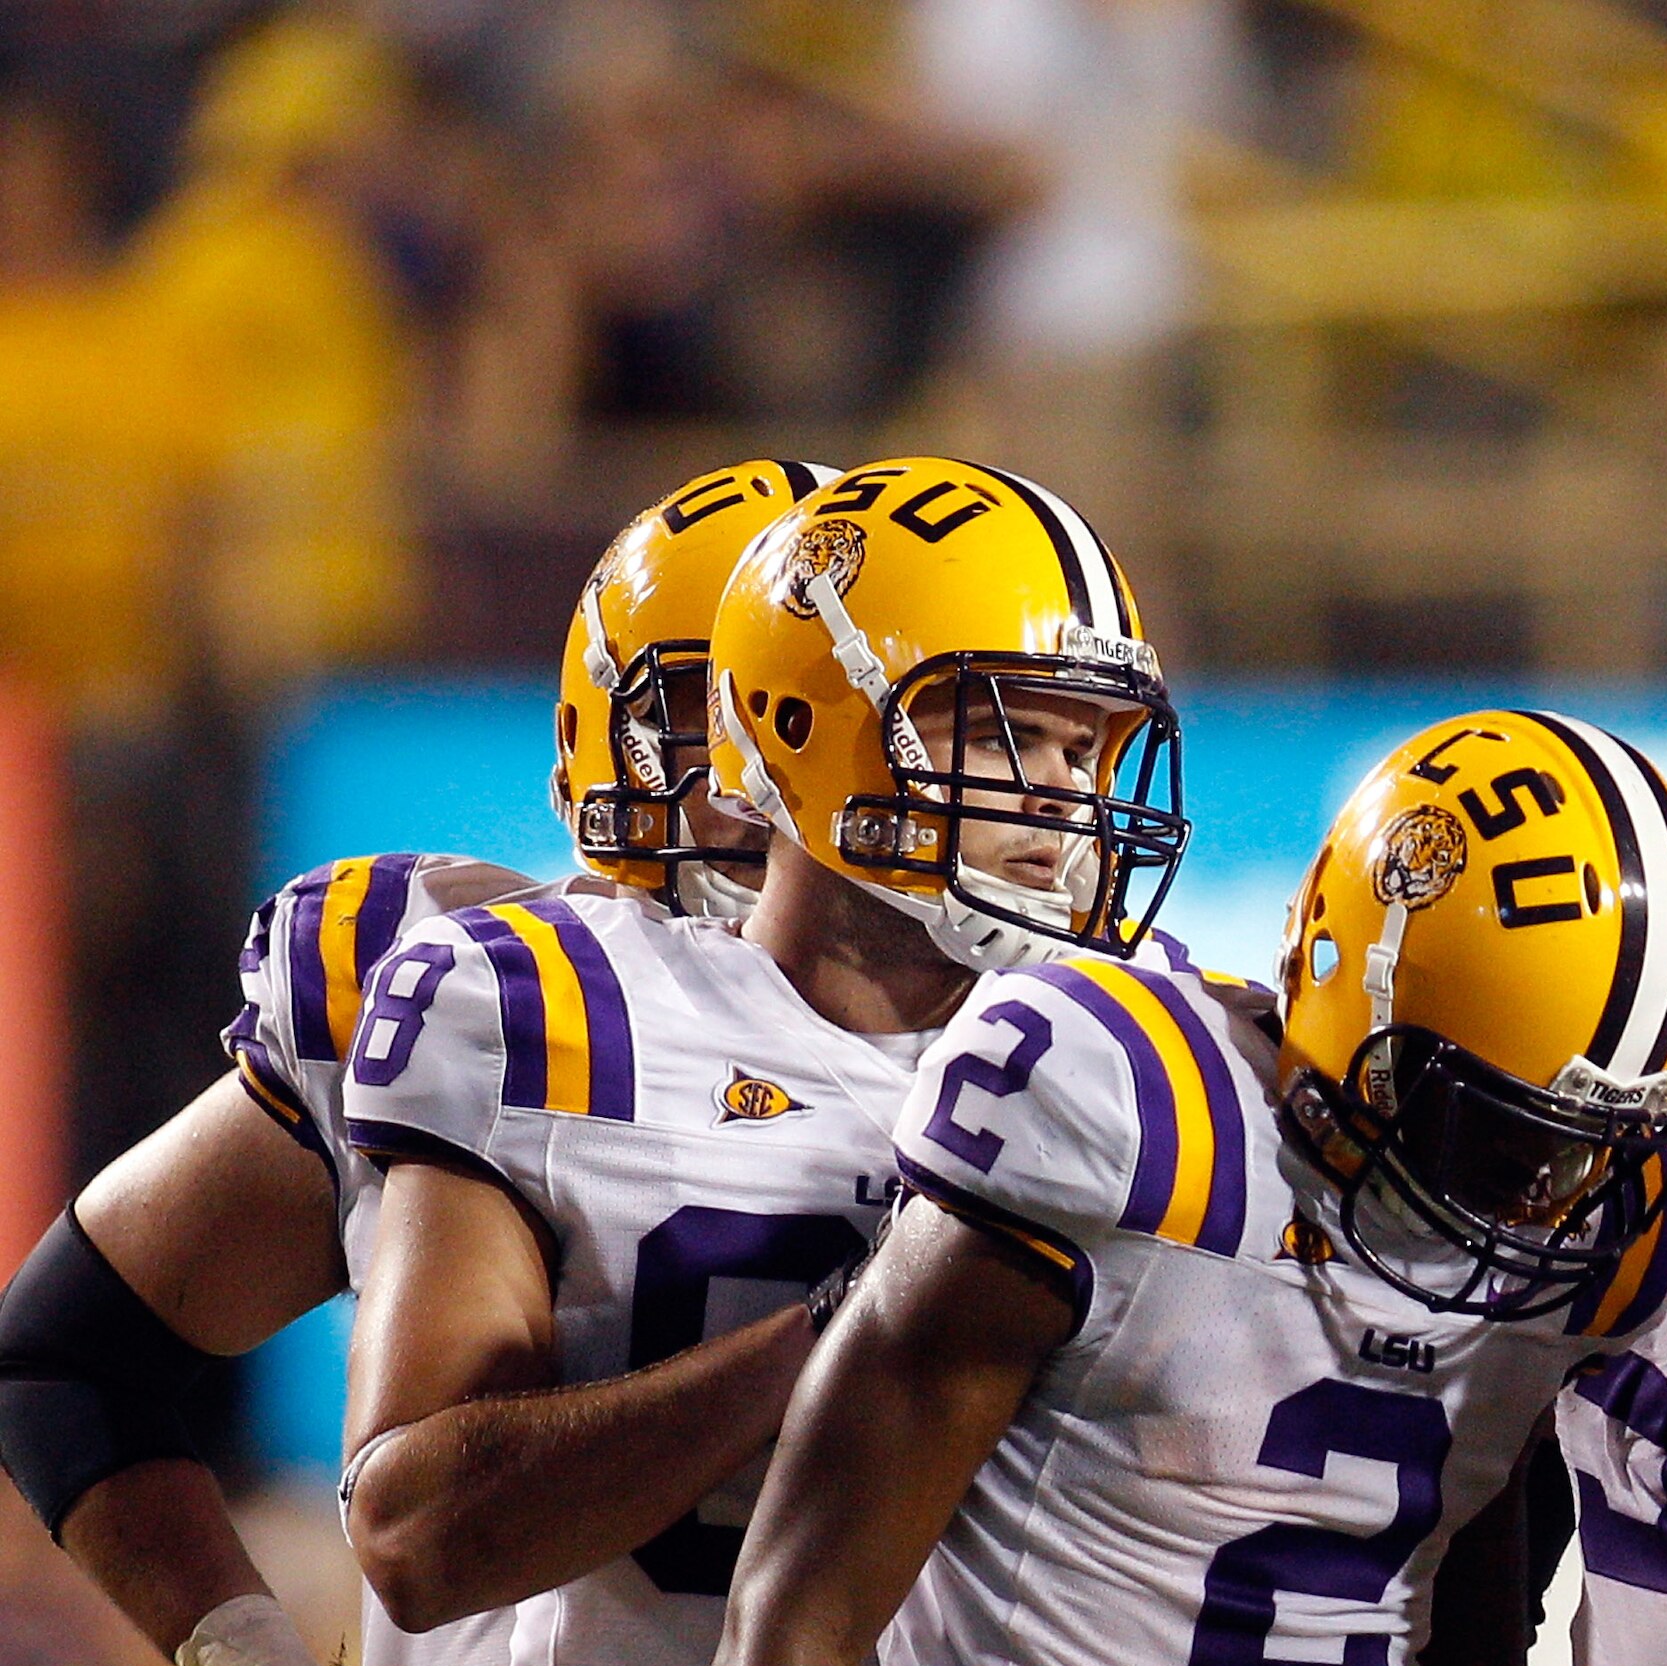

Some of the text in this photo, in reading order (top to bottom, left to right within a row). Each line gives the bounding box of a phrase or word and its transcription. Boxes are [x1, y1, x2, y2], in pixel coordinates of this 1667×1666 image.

[1410, 730, 1583, 930] LSU
[351, 942, 457, 1086] 8
[738, 1083, 775, 1117] SEC
[920, 1002, 1055, 1177] 2
[1590, 1080, 1646, 1104] TIGERS
[1359, 1328, 1435, 1373] LSU
